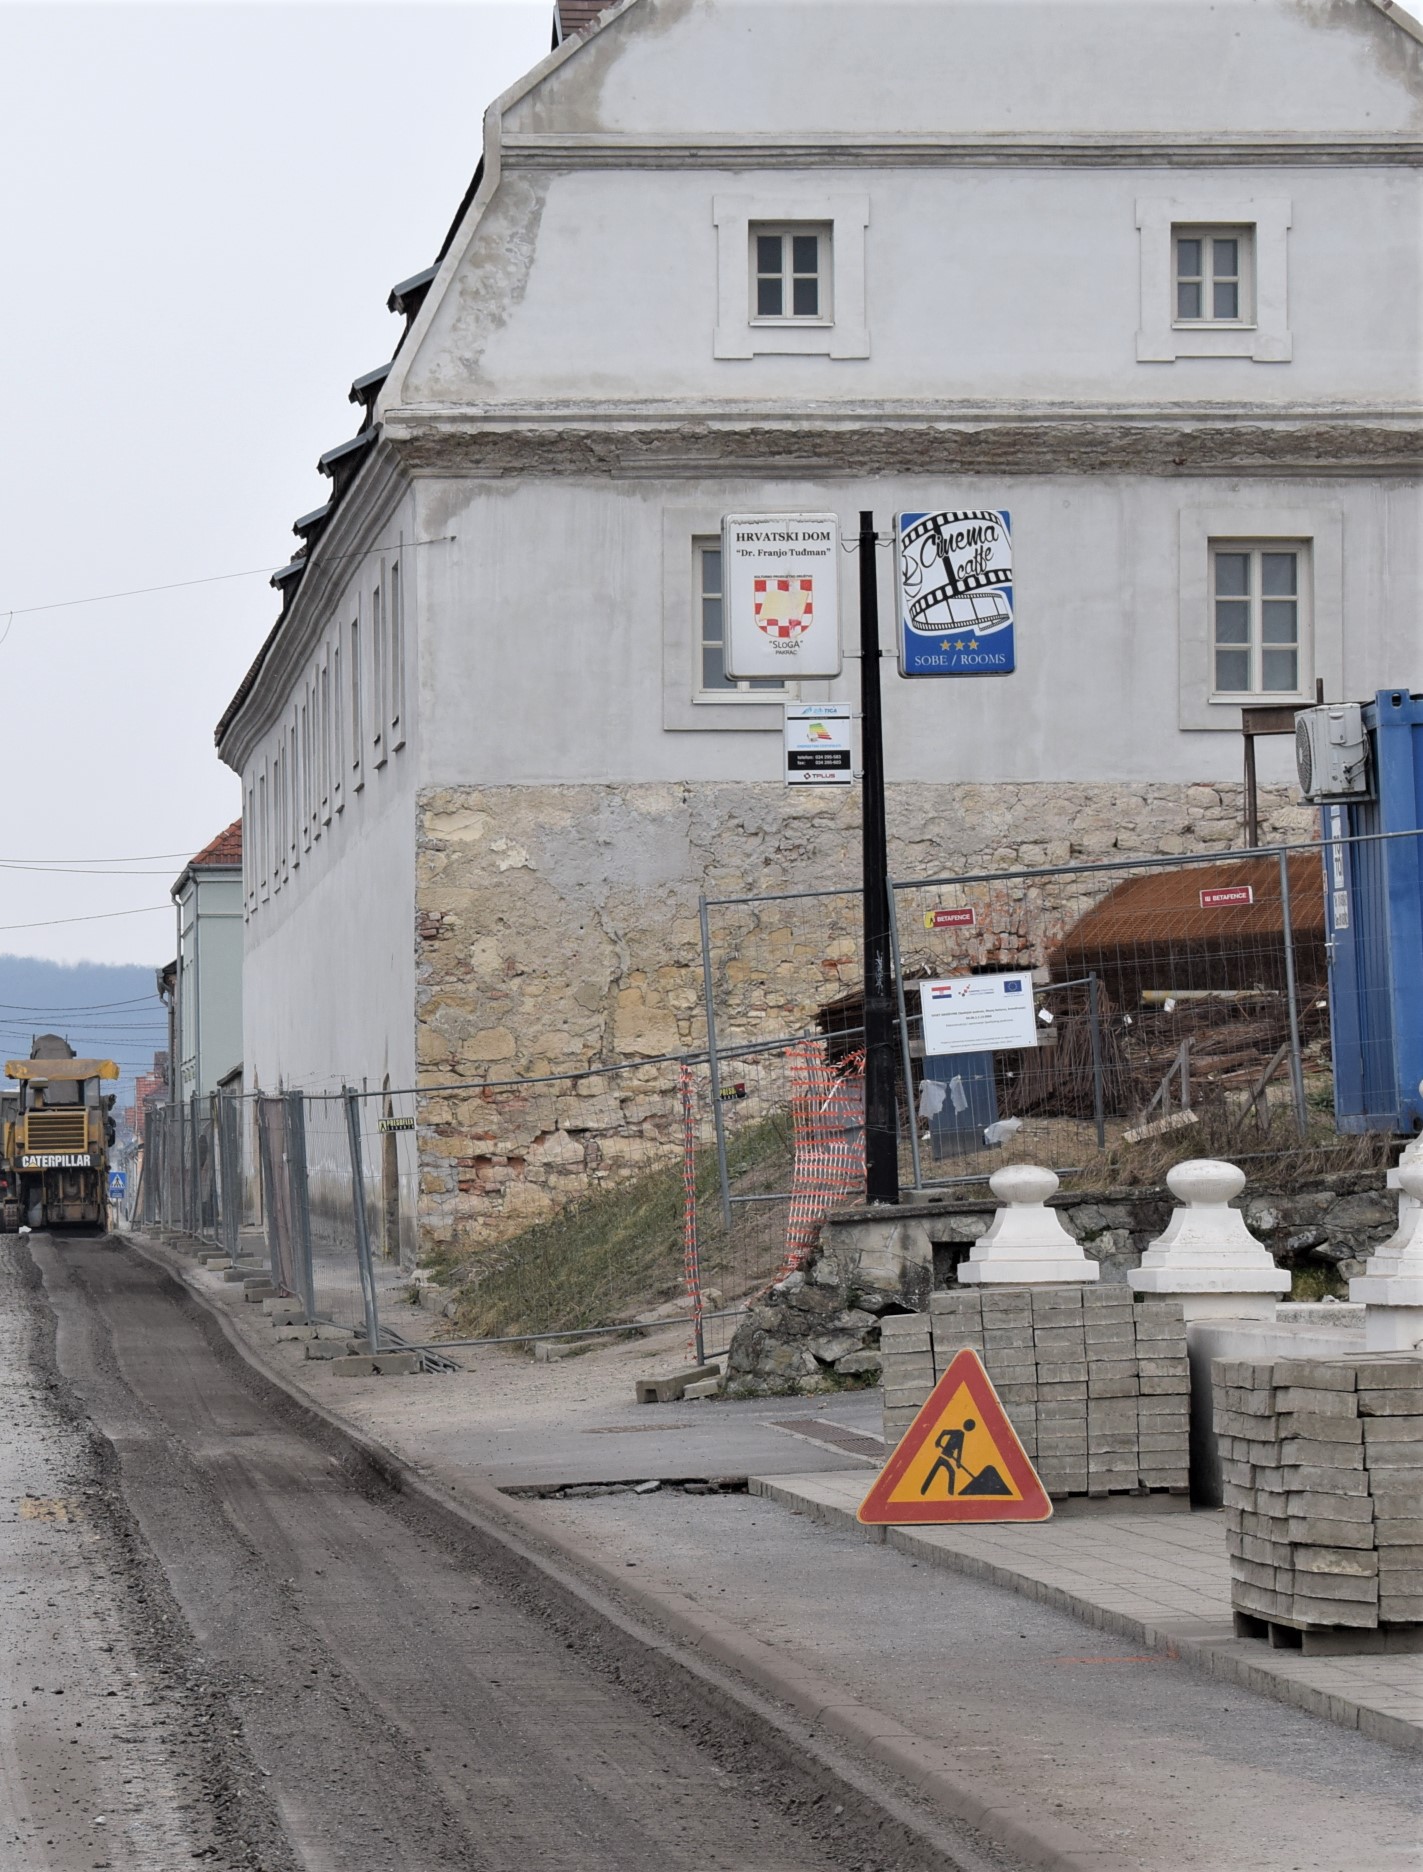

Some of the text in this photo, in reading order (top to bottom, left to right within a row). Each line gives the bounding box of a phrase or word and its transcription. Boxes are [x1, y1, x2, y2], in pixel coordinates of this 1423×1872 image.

[736, 531, 830, 542] HRVATSKI DOM
[920, 525, 999, 568] Cinema
[758, 548, 787, 558] Franjo
[957, 545, 994, 580] caffe
[914, 653, 1006, 667] SOBE / ROOMS
[1212, 892, 1247, 901] BETAFENCE
[937, 914, 971, 923] BETAFENCE
[22, 1154, 91, 1168] CATERPILLAR
